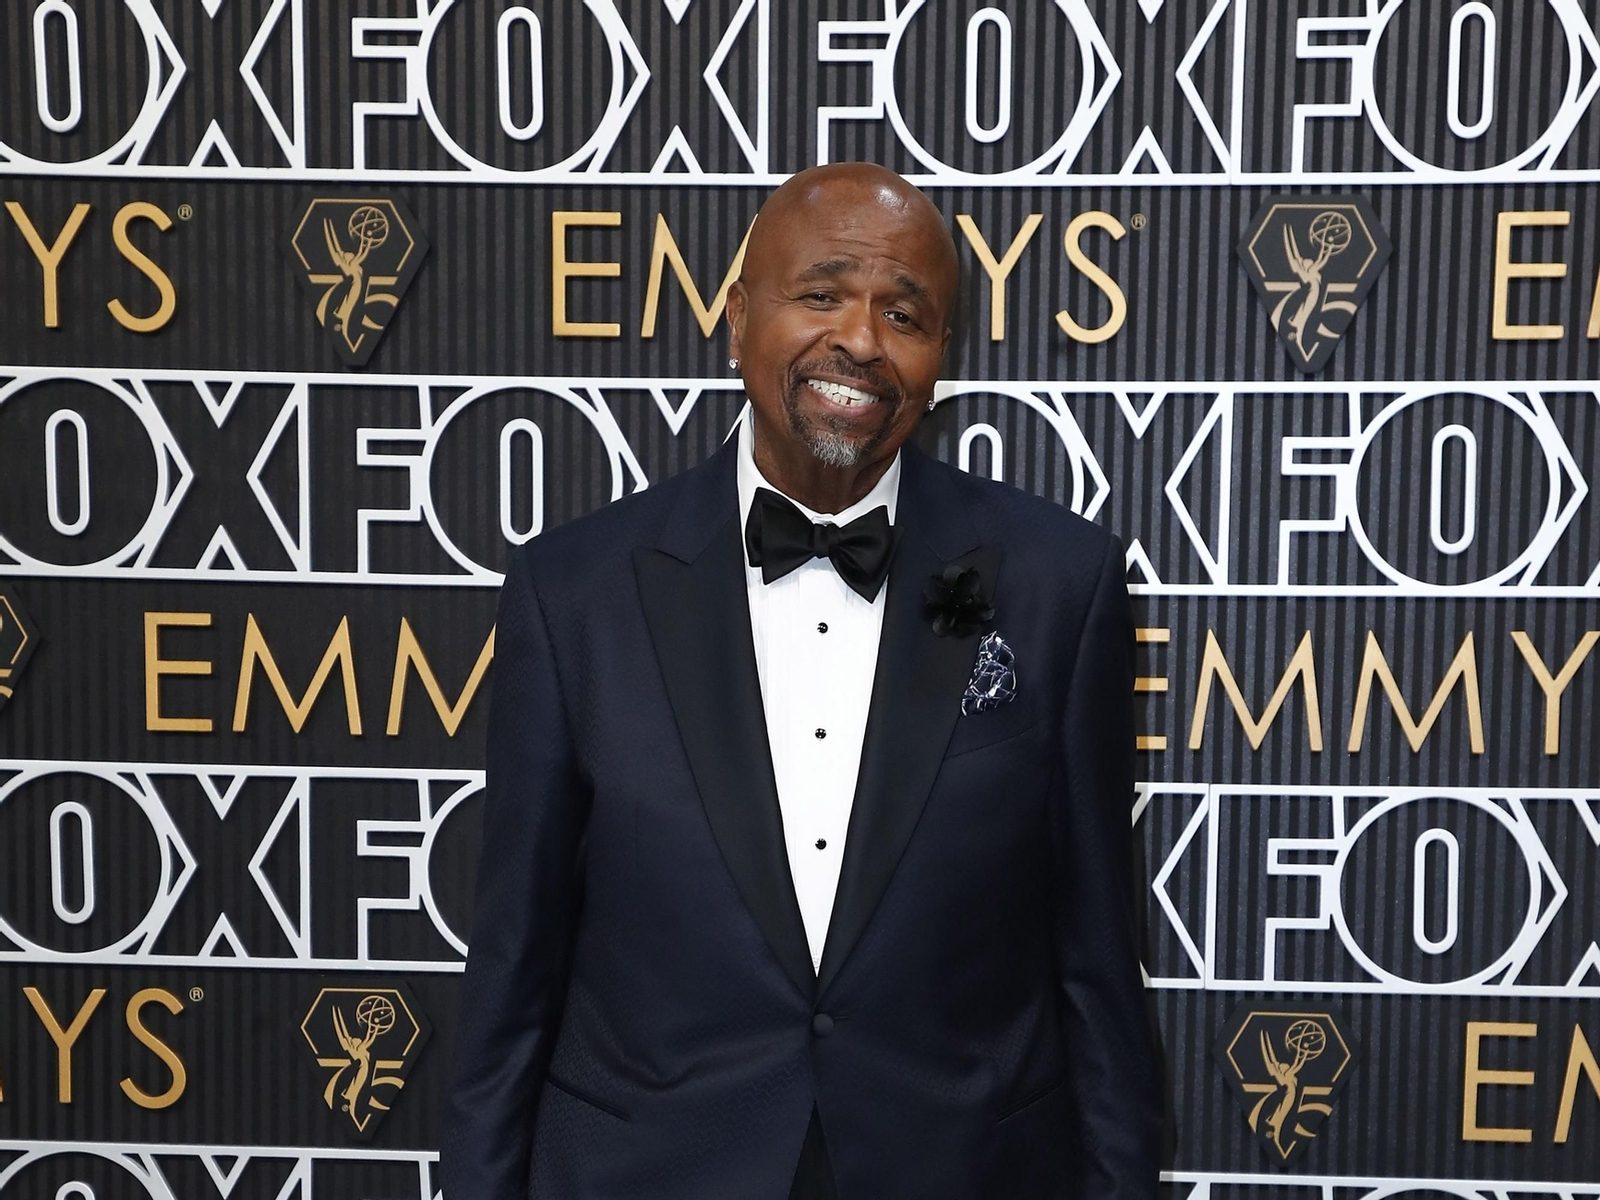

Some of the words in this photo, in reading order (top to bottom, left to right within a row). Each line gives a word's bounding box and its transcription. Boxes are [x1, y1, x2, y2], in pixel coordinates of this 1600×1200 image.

[0, 0, 300, 178] OX
[293, 0, 767, 185] FOX
[760, 0, 1232, 187] FOX
[0, 367, 308, 582] OX
[144, 612, 497, 737] EMM
[0, 759, 310, 967] OX
